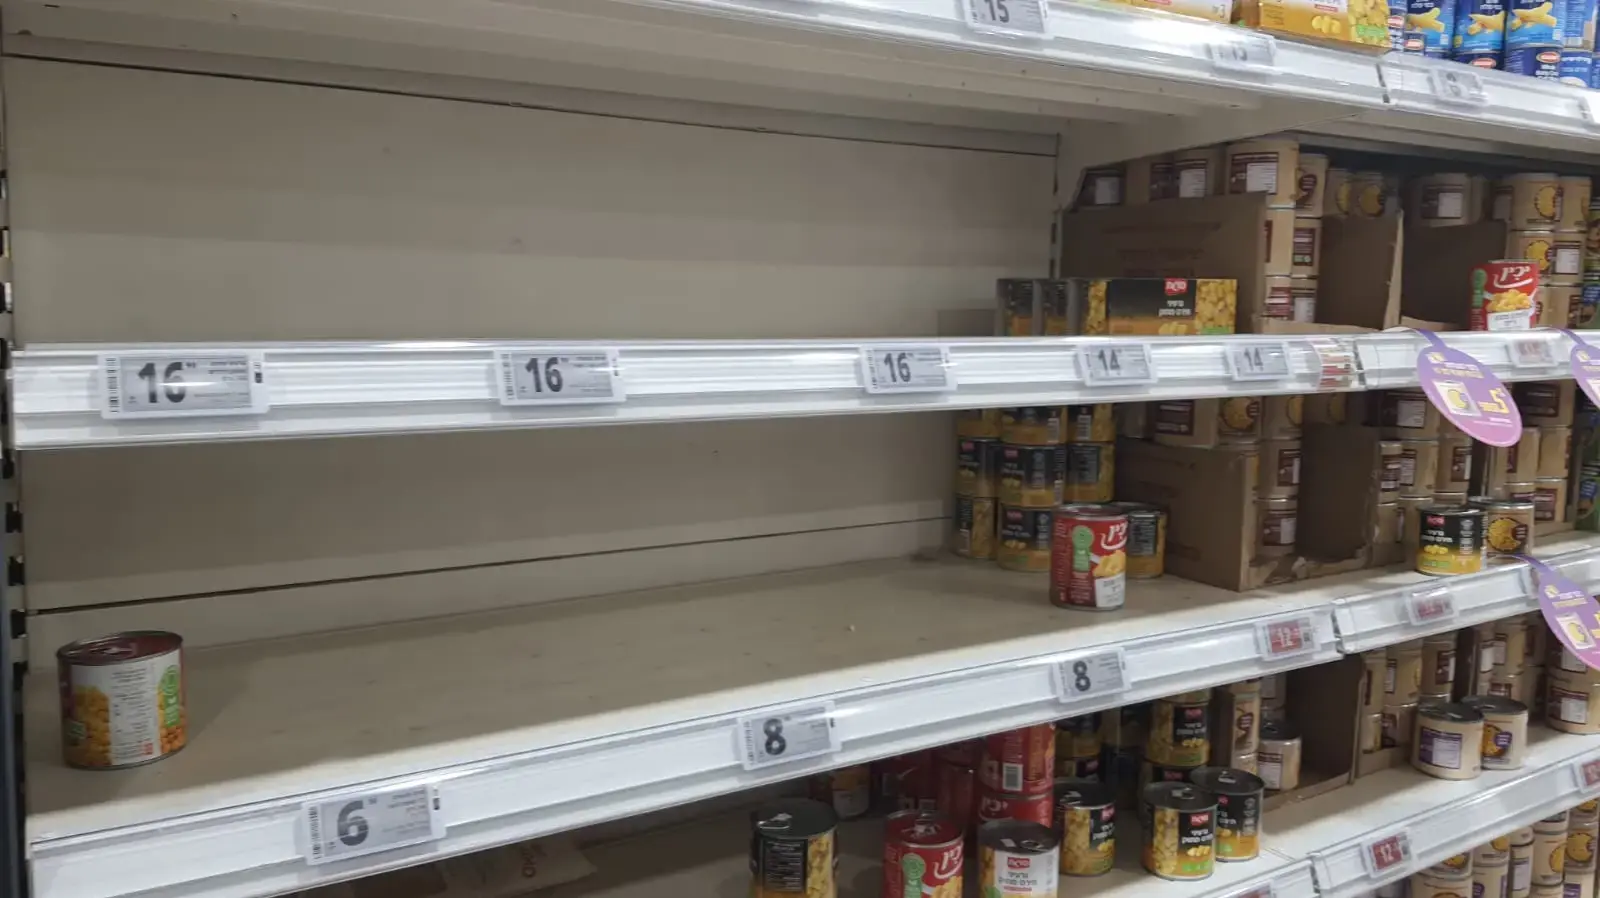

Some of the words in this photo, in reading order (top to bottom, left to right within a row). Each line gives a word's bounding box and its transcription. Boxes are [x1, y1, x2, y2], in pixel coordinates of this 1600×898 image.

[525, 357, 563, 393] 16
[883, 352, 911, 383] 16
[1098, 349, 1121, 376] 14
[1243, 347, 1264, 371] 14
[138, 362, 186, 403] 16
[1073, 661, 1091, 692] 8
[763, 718, 787, 756] 8
[337, 800, 369, 846] 6
